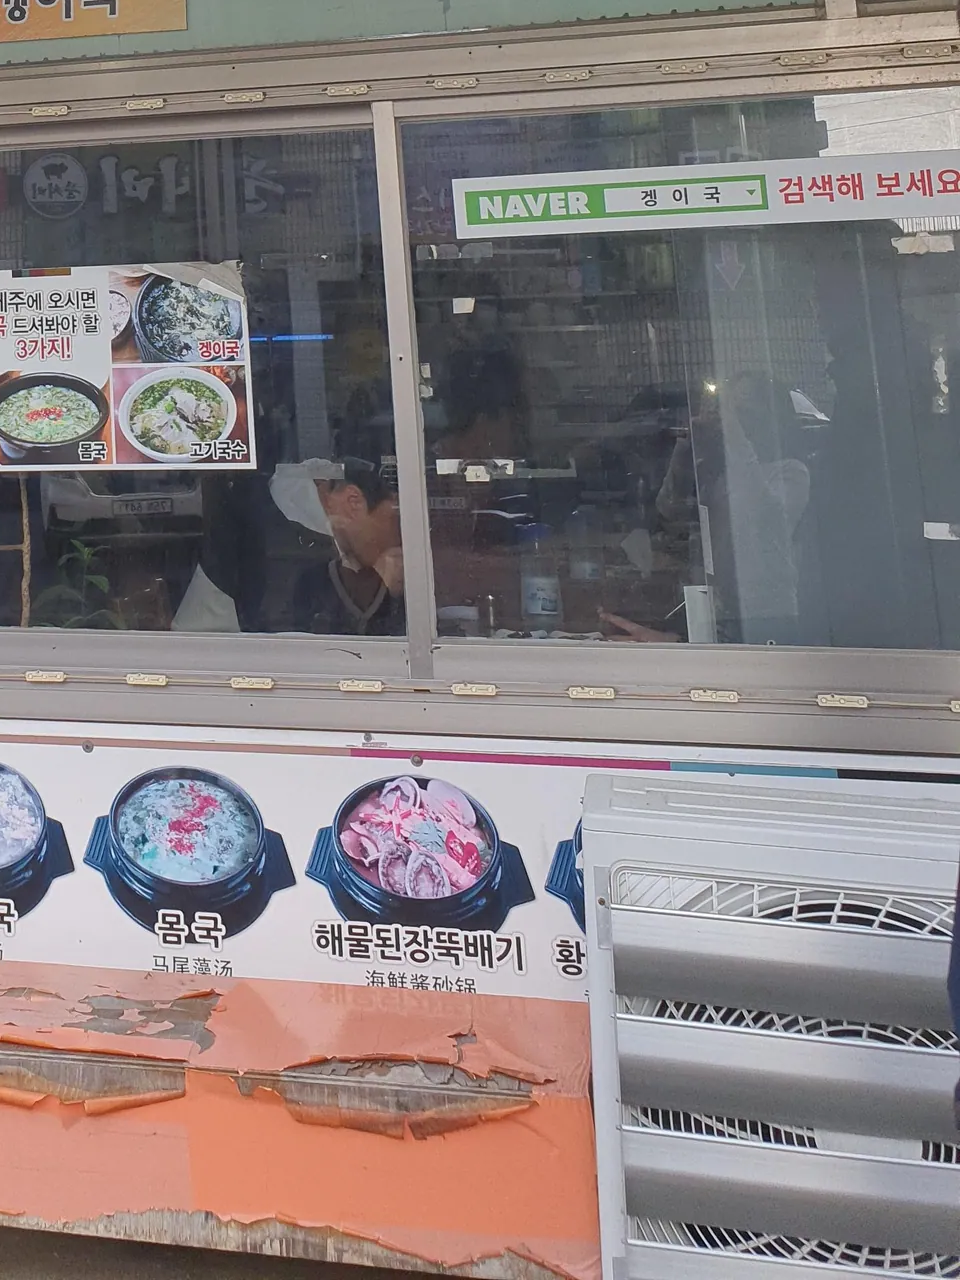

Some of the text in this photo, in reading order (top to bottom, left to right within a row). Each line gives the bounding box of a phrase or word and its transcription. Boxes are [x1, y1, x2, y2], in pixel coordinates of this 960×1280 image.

[779, 169, 960, 204] 검색해 보세요
[479, 191, 591, 219] NAVER
[48, 290, 96, 310] 오시면
[12, 315, 77, 334] 드셔봐야
[82, 314, 99, 333] 할
[16, 336, 71, 359] 3가지!
[78, 441, 107, 461] 몸국
[189, 440, 246, 460] 고기국수
[315, 923, 523, 971] 해물된장뚝배기
